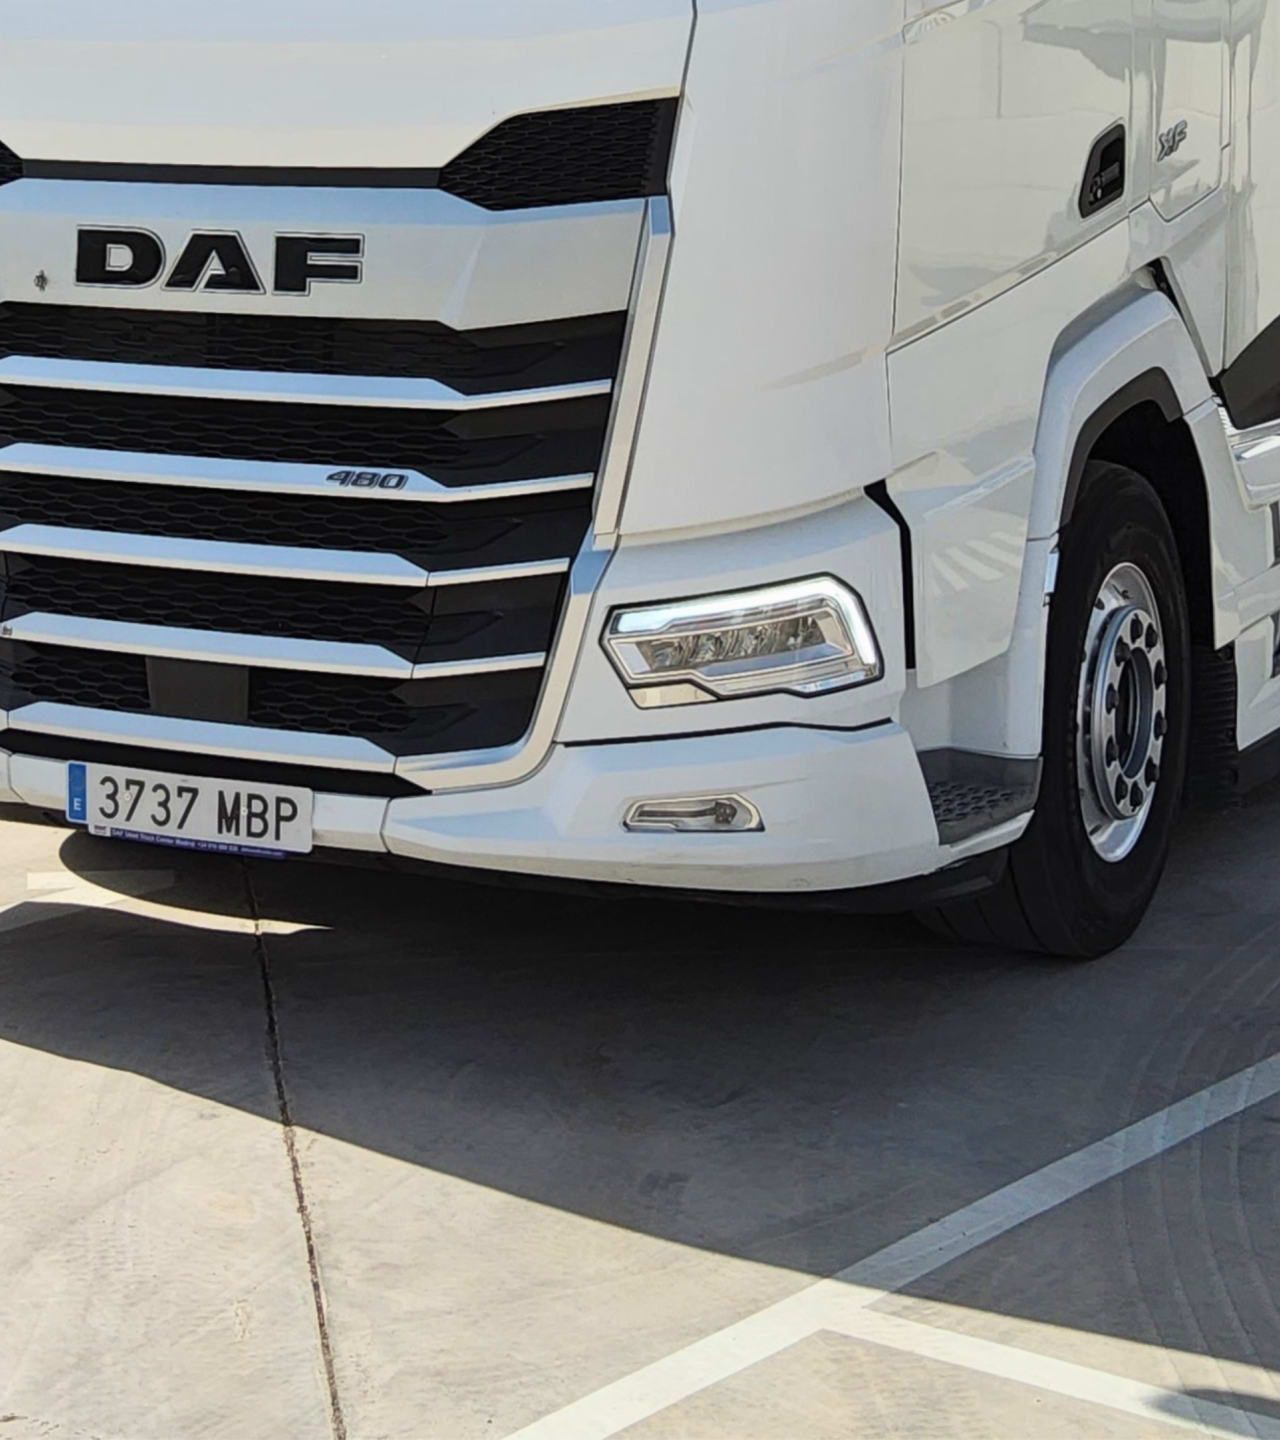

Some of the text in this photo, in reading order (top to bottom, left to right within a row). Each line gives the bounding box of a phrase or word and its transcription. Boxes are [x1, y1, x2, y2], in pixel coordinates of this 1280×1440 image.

[73, 224, 366, 296] DAF
[325, 470, 410, 491] 480
[73, 797, 82, 811] E
[98, 775, 299, 841] 3737 MBP
